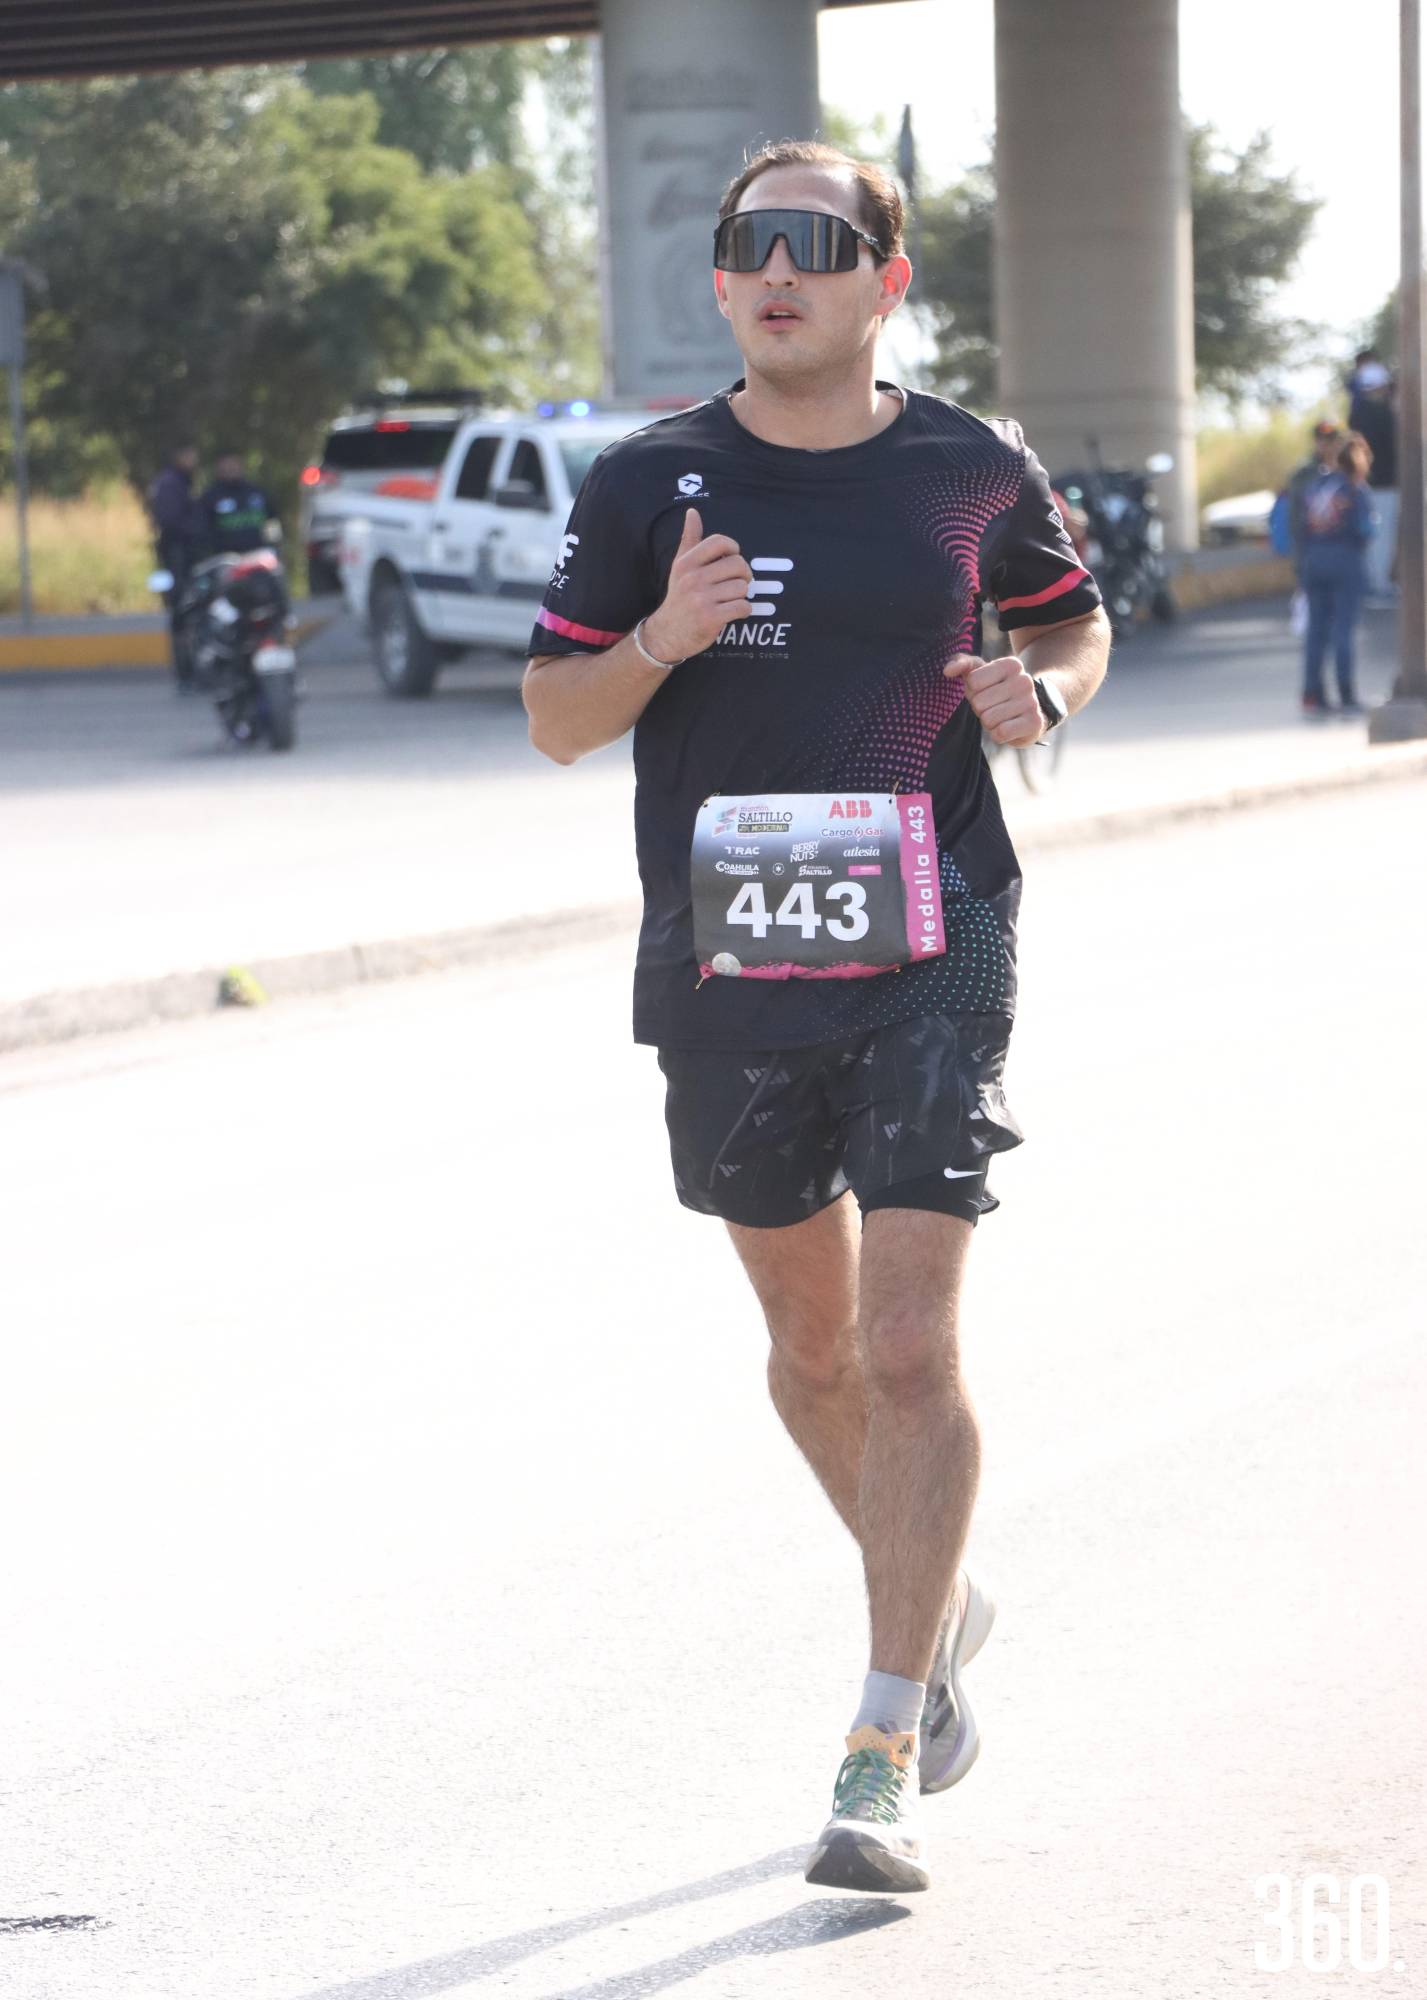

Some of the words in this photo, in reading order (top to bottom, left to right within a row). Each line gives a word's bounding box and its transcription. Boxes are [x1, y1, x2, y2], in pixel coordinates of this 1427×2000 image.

[828, 799, 873, 819] ABB
[738, 811, 793, 823] SALTILLO
[907, 805, 927, 844] 443
[821, 828, 853, 839] Cargo
[865, 827, 886, 837] Gas
[792, 840, 820, 854] BERRY
[790, 850, 816, 863] NUTS
[715, 860, 760, 873] COAHUILA
[914, 854, 938, 953] Medalla
[726, 881, 870, 942] 443
